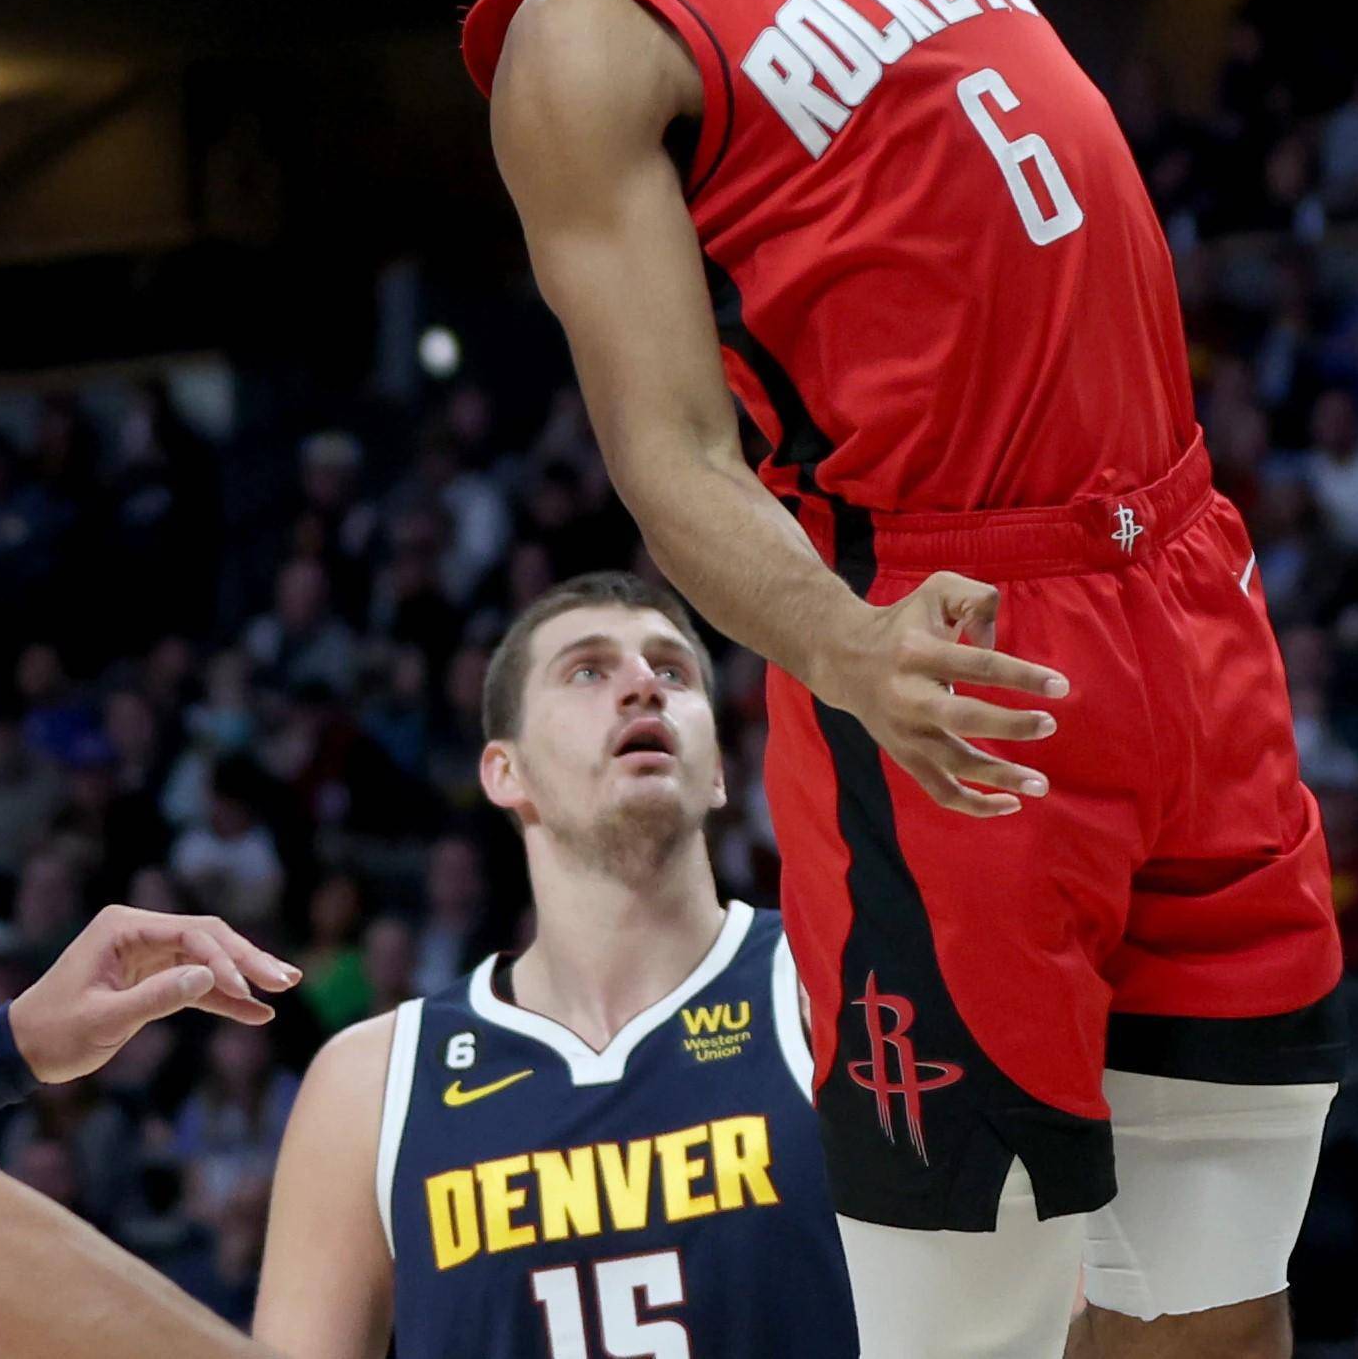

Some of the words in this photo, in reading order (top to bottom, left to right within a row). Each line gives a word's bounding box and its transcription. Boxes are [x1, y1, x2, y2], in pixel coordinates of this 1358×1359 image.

[956, 67, 1084, 246] 6
[681, 1001, 751, 1035] WU
[445, 1031, 476, 1069] 6
[683, 1031, 752, 1052] Western
[696, 1045, 742, 1062] Union
[424, 1114, 780, 1272] DENVER
[530, 1248, 692, 1359] 15
